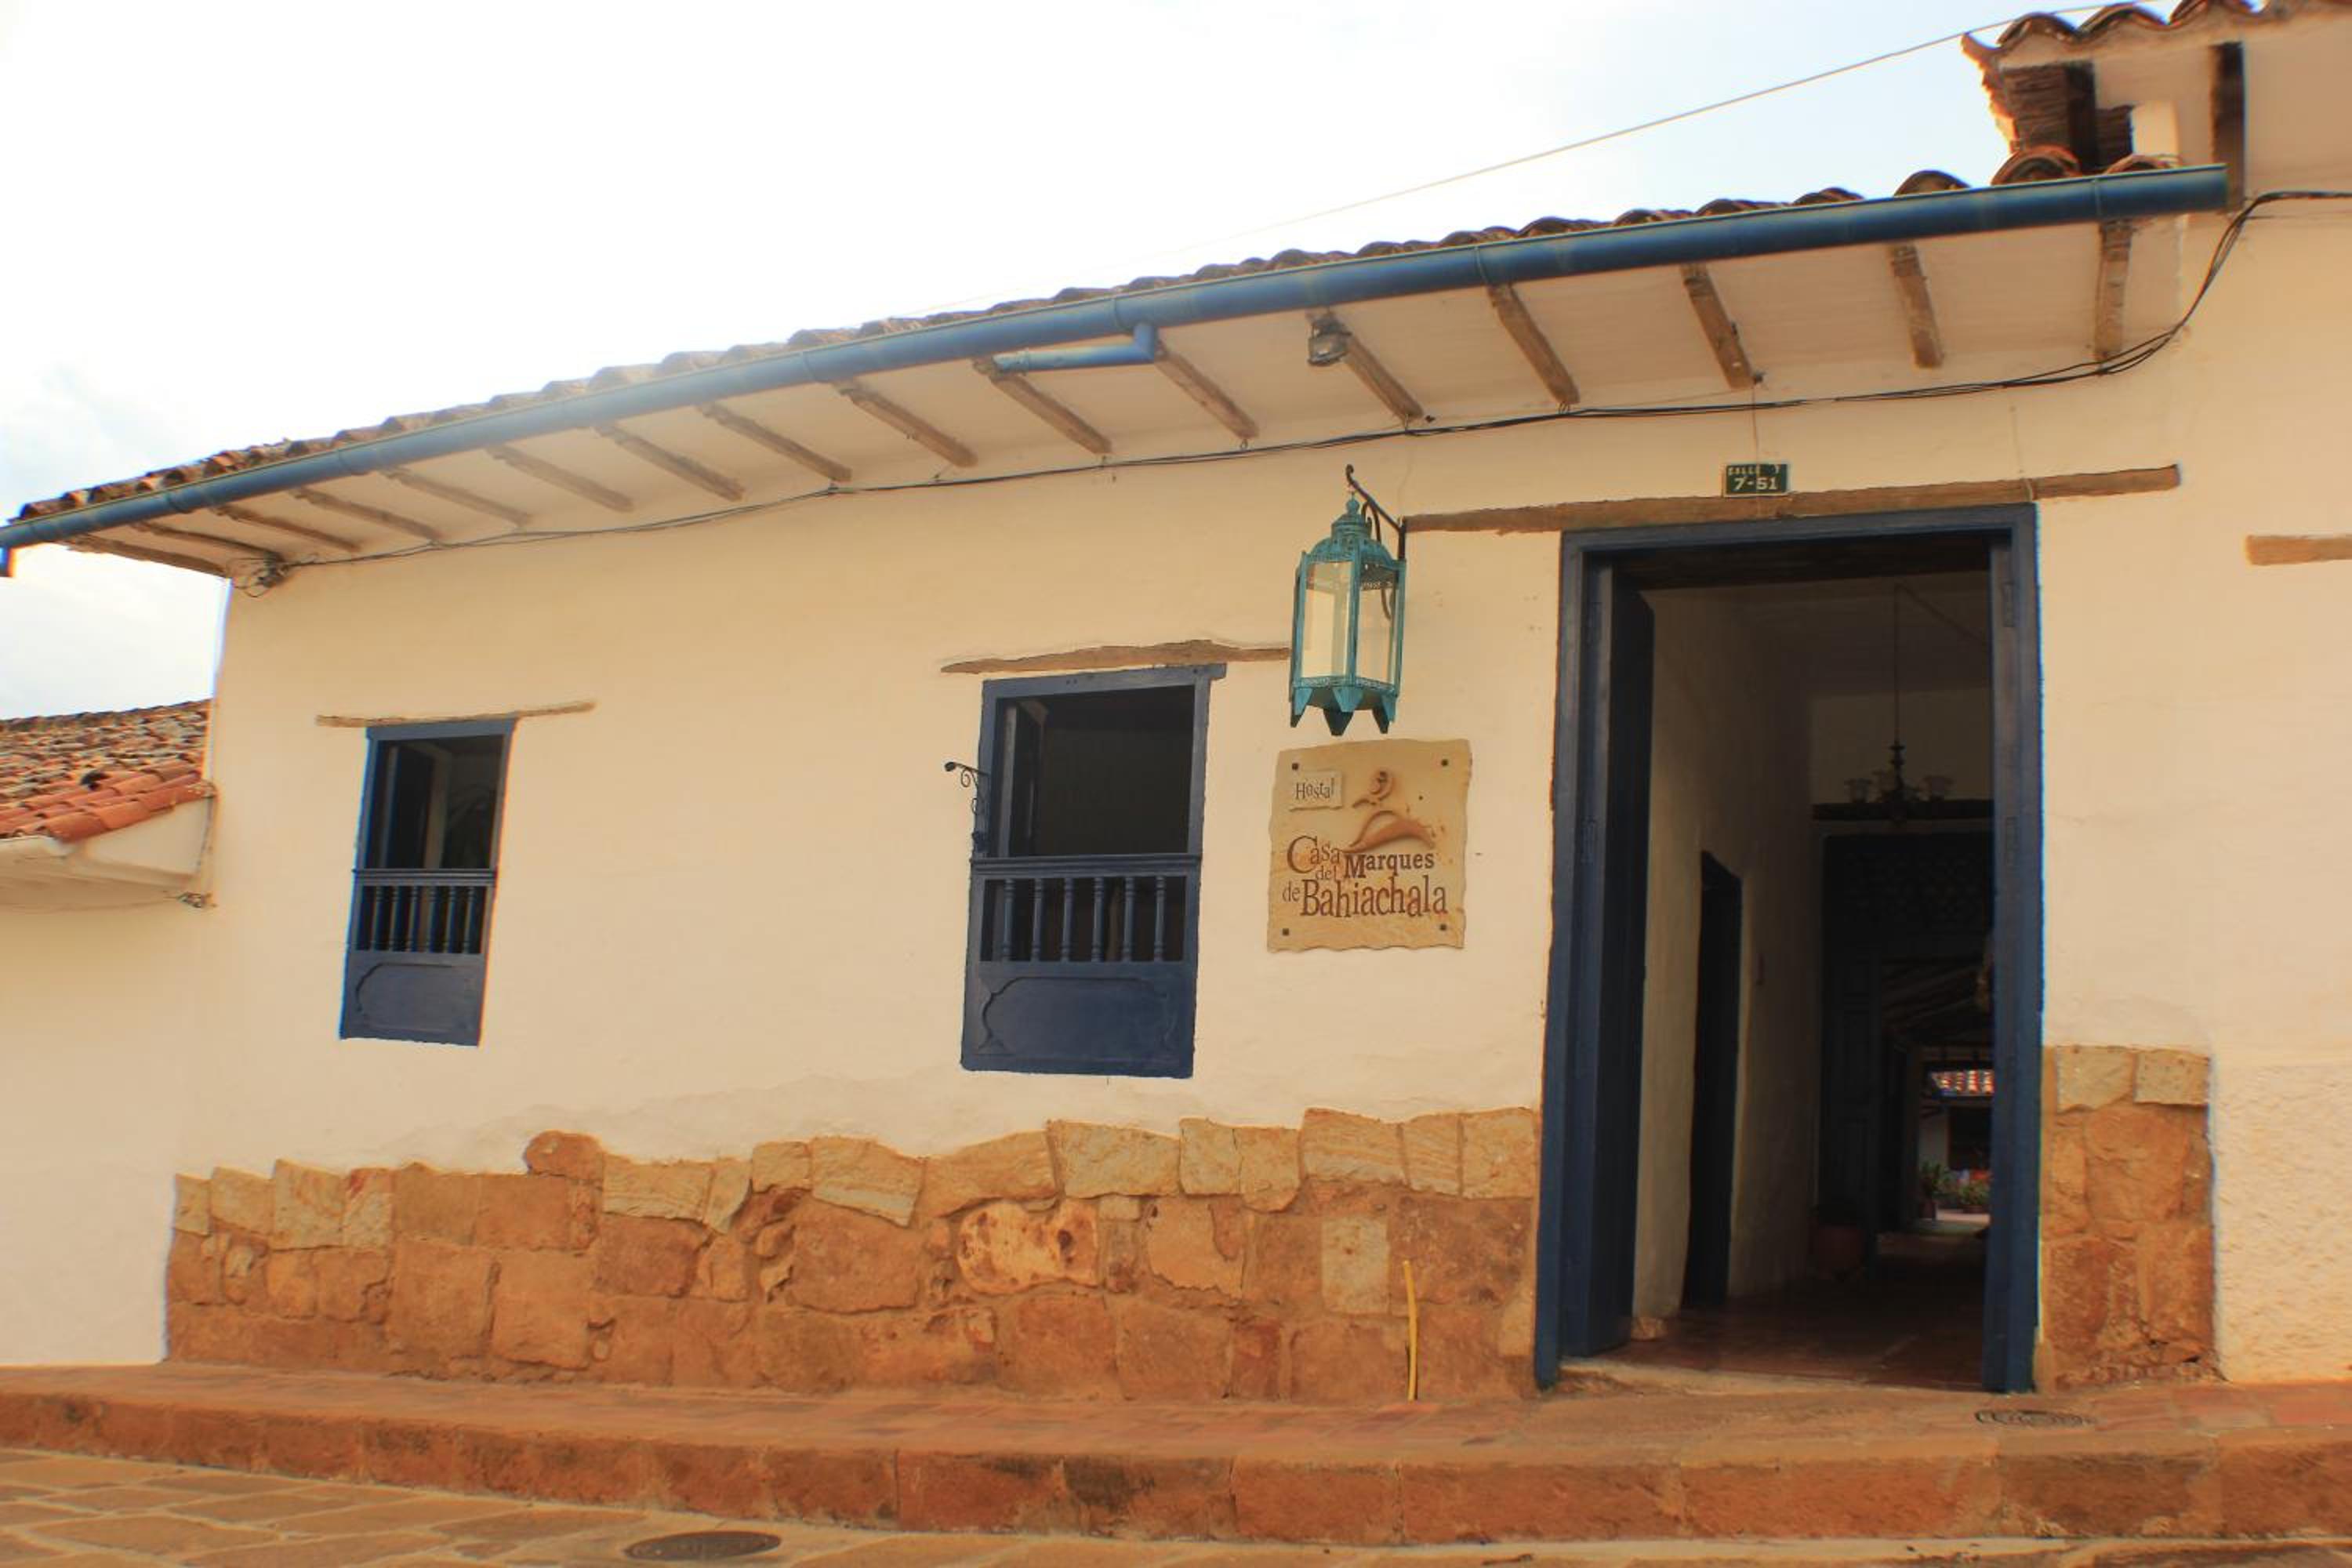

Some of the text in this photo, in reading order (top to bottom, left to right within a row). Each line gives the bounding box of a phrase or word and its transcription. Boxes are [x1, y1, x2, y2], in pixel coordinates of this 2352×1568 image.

[1733, 477, 1777, 490] 7-51
[1295, 778, 1335, 800] Hostal
[1287, 835, 1342, 873] Casa
[1316, 852, 1434, 880] del Marques
[1282, 875, 1448, 918] de Bahiachala
